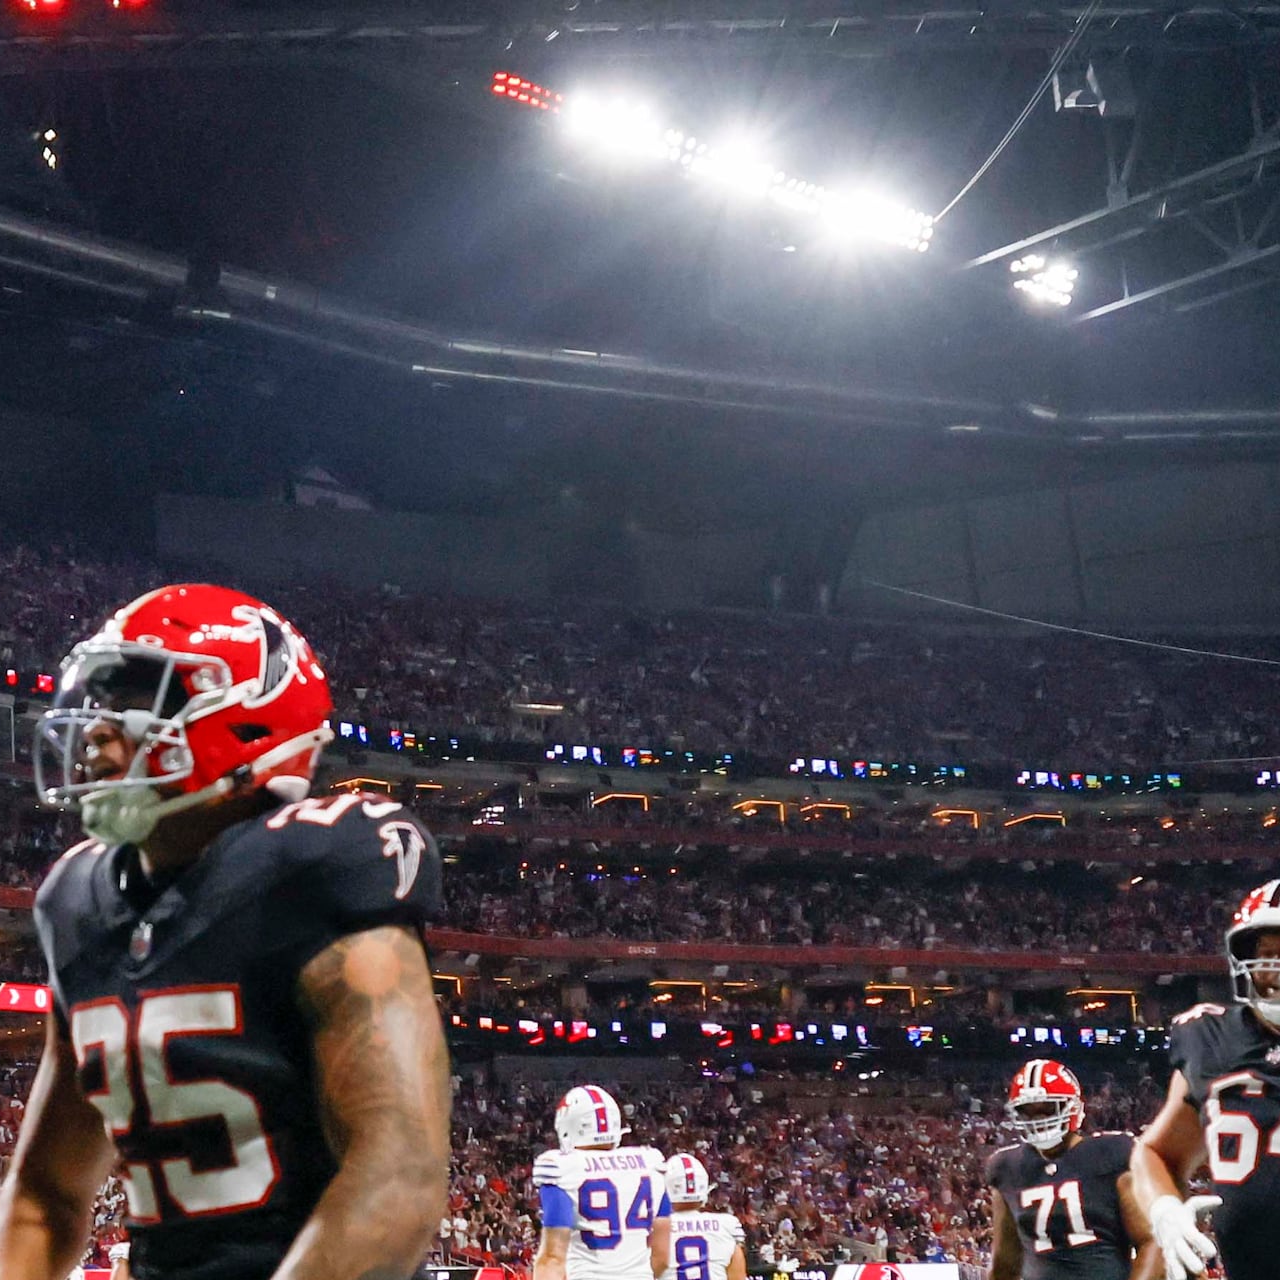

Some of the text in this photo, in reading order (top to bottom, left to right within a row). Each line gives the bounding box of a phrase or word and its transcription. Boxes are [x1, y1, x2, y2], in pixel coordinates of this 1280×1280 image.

[34, 988, 48, 1008] 0
[584, 1154, 647, 1173] JACKSON
[578, 1175, 654, 1250] 94
[1021, 1180, 1100, 1252] 71
